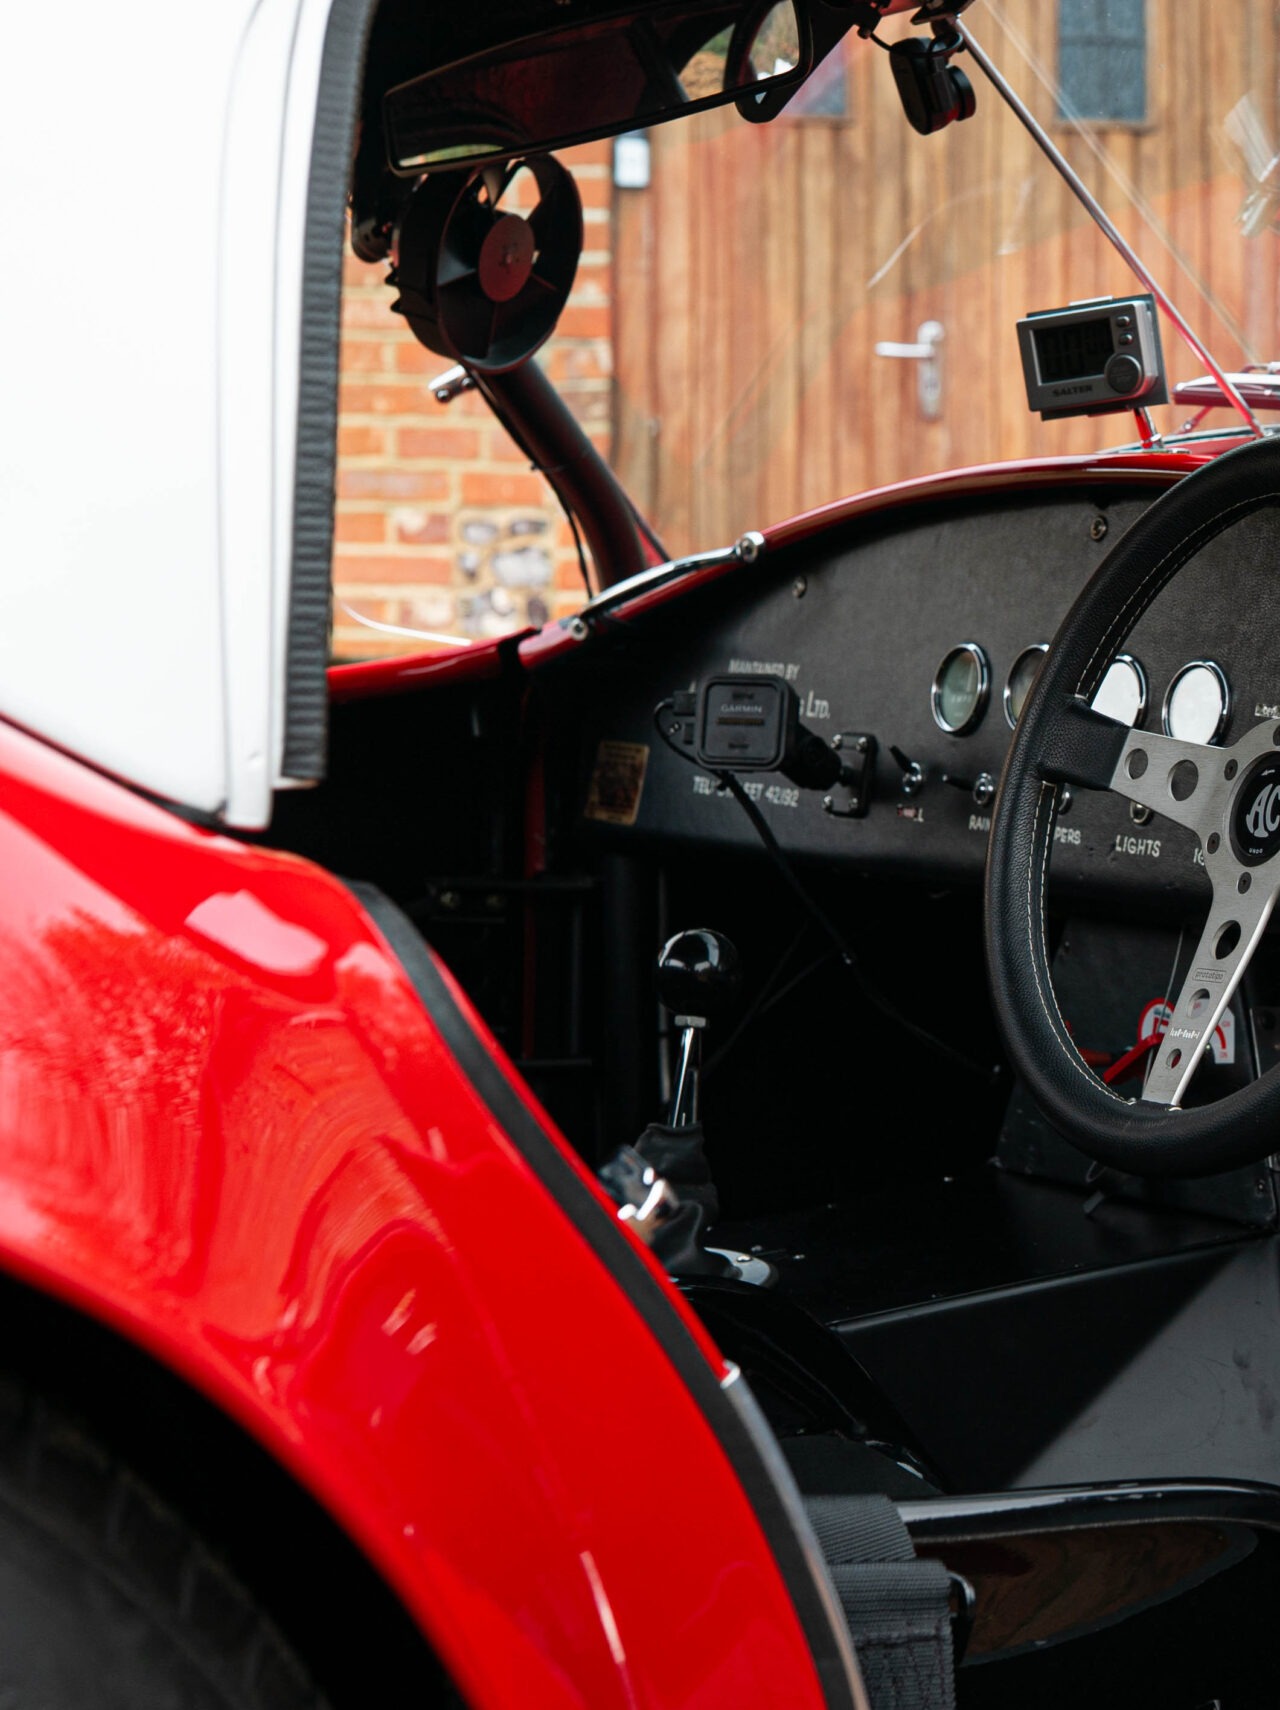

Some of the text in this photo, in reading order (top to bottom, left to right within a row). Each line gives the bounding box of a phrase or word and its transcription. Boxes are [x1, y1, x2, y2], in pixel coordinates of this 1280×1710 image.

[1052, 385, 1093, 397] SALTER
[720, 703, 762, 713] GARMIN
[1115, 834, 1161, 858] LIGHTS
